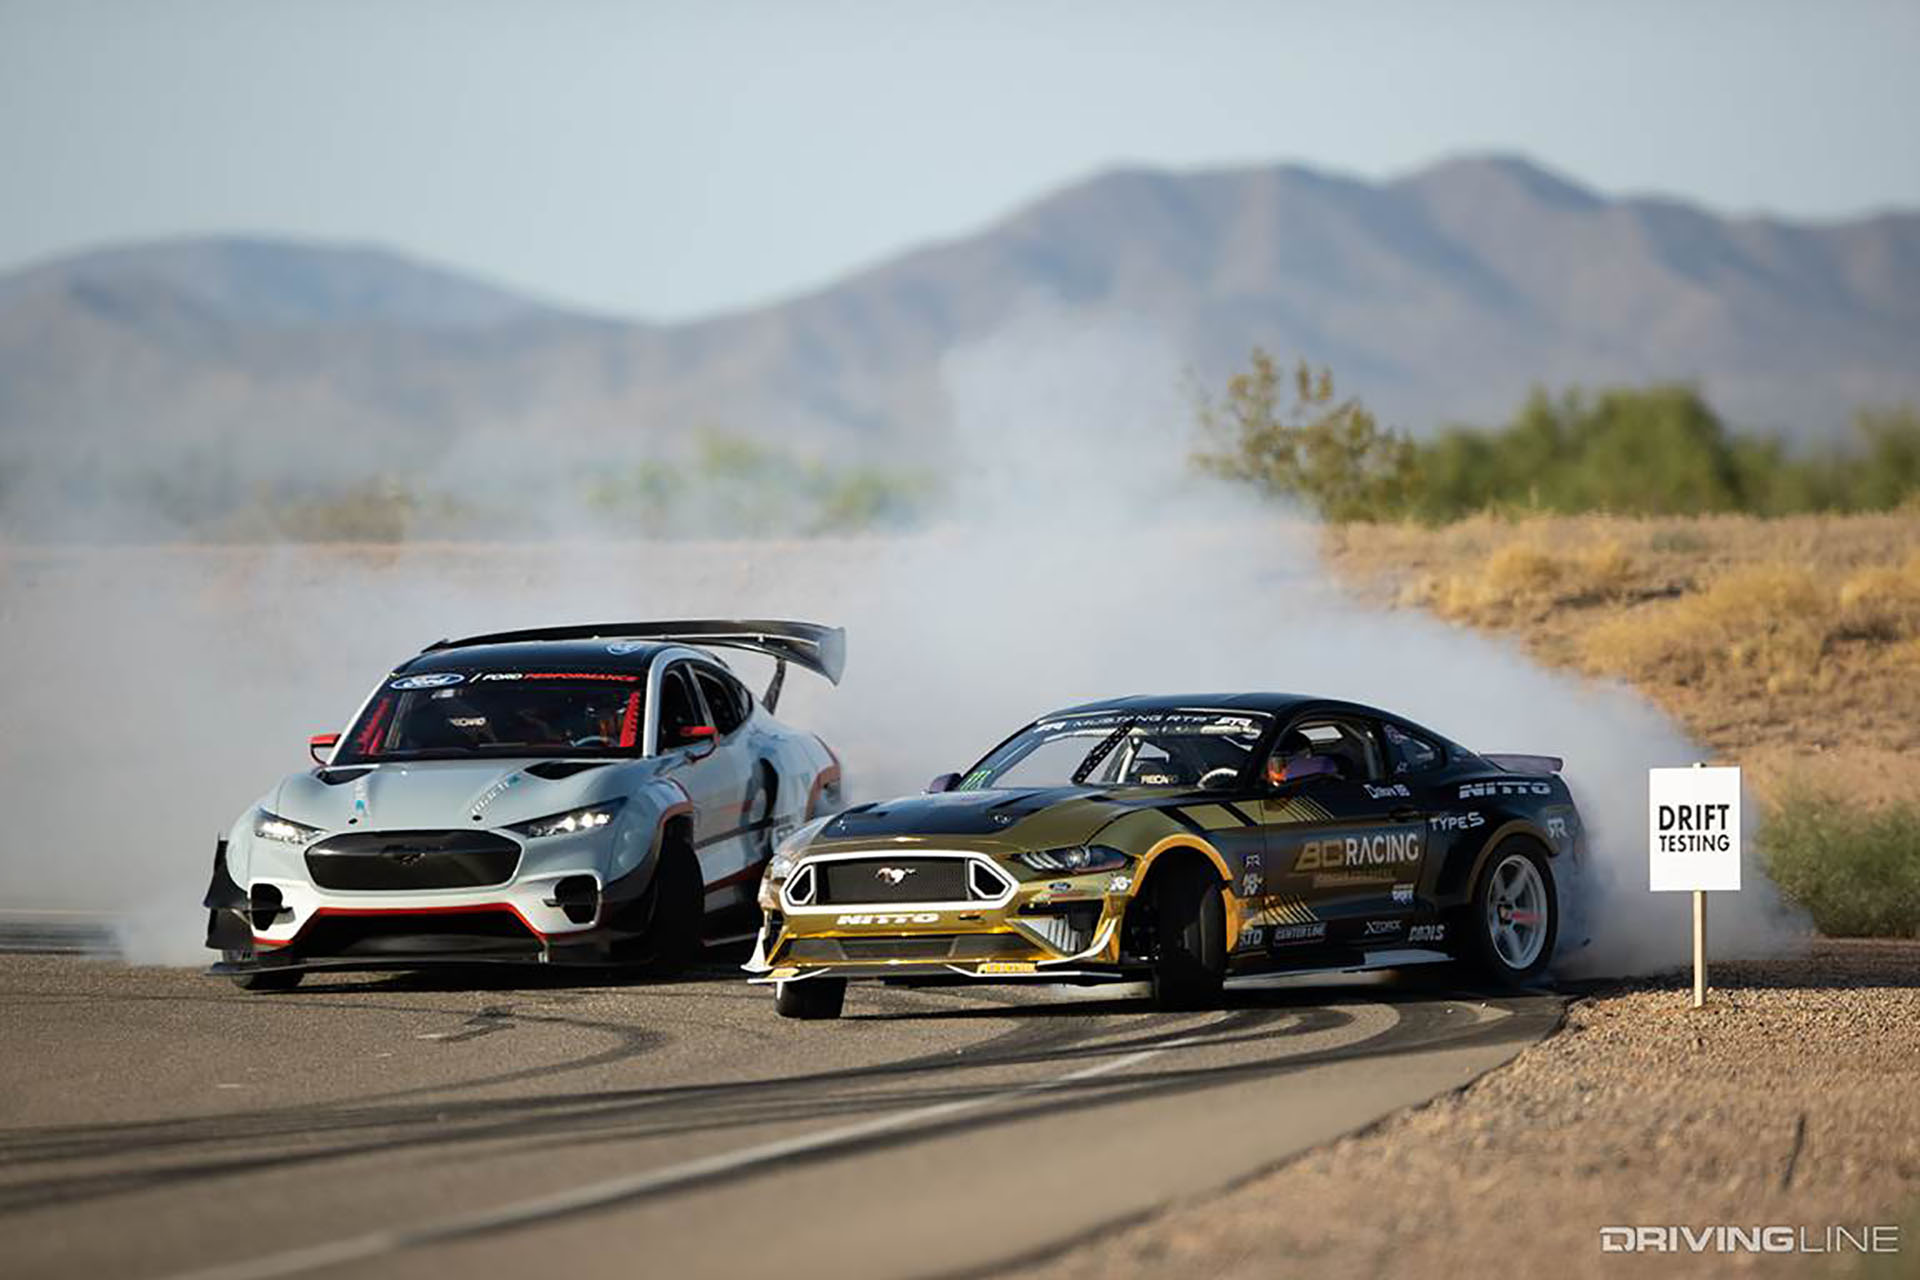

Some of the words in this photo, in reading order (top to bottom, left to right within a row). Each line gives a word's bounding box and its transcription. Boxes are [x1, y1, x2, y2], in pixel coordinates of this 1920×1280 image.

[1459, 781, 1551, 799] NITTO
[1659, 804, 1730, 830] DRIFT
[1659, 834, 1730, 852] TESTING
[836, 912, 941, 926] NITTO
